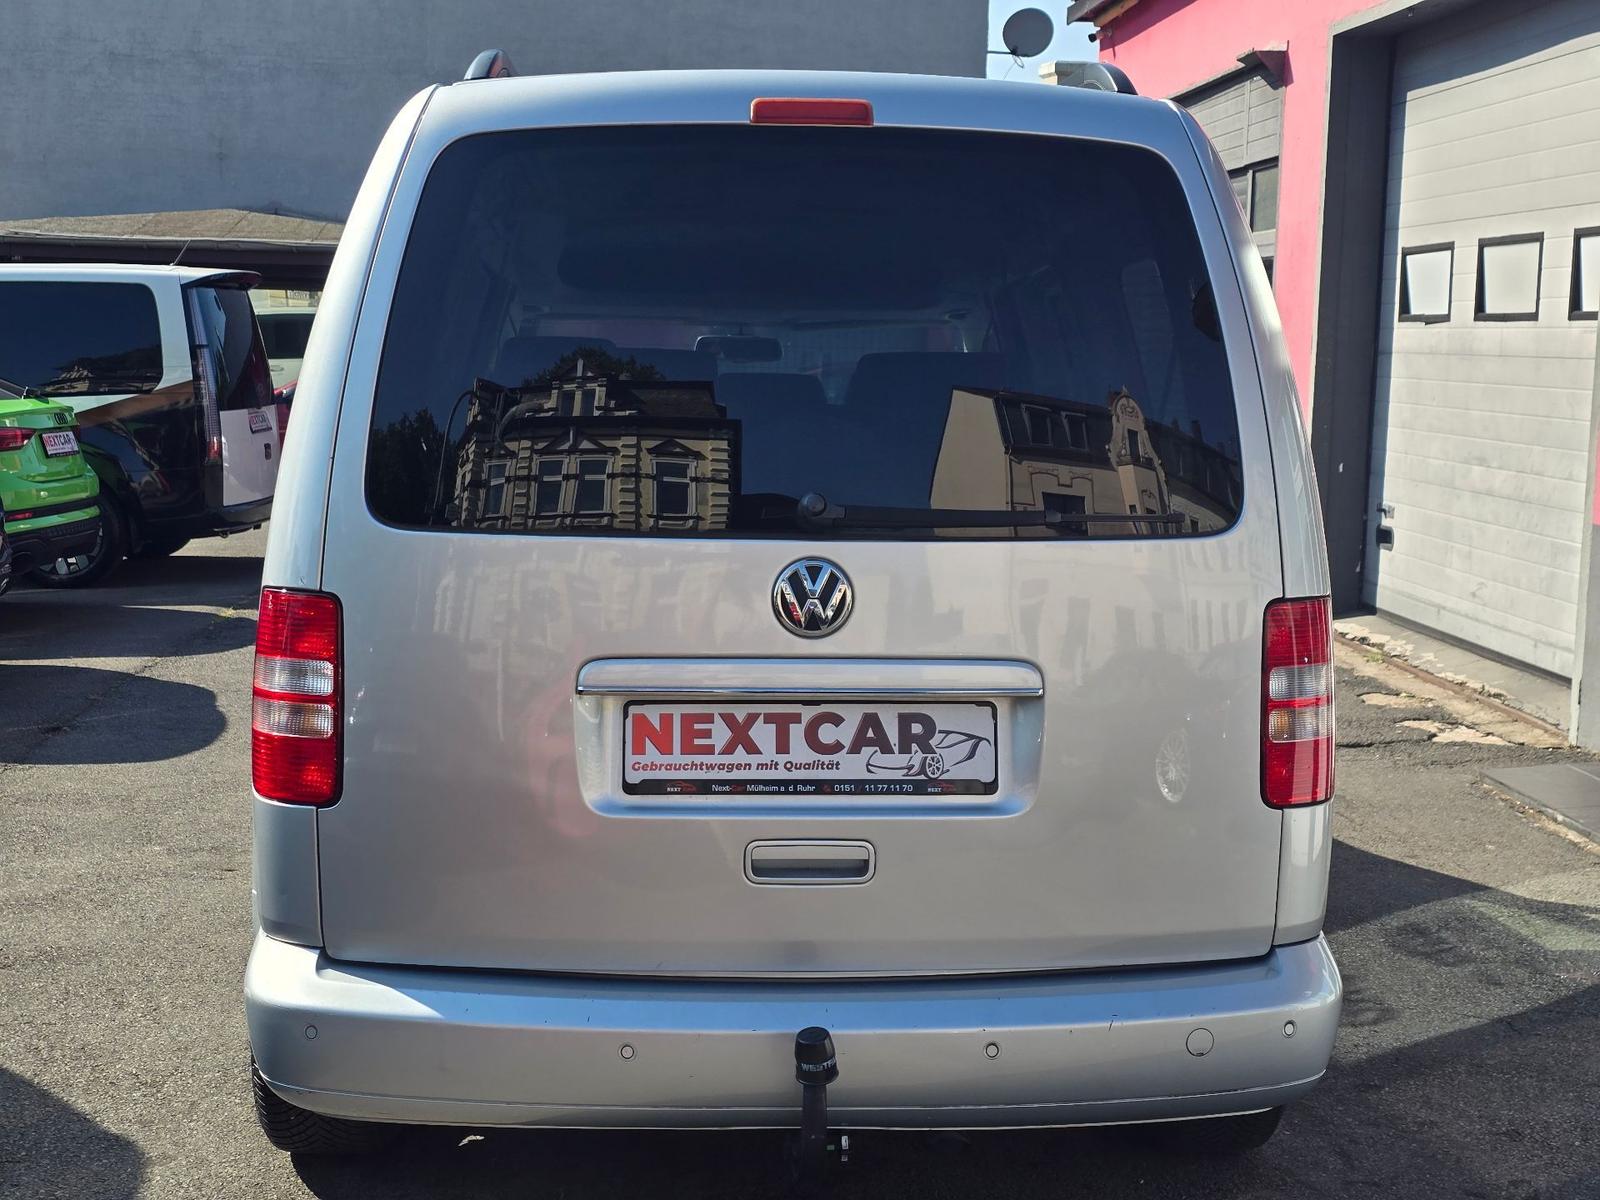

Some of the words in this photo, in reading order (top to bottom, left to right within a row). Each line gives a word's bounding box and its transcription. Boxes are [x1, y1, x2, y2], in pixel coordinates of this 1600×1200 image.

[45, 433, 72, 448] NEXTCAR
[631, 711, 938, 756] NEXTCAR
[631, 759, 752, 773] Gebrauchtwagen
[756, 759, 779, 771] mit
[783, 759, 840, 772] Qualität
[747, 784, 778, 792] Mülheim
[797, 784, 815, 792] Ruhr
[834, 784, 855, 792] 0151
